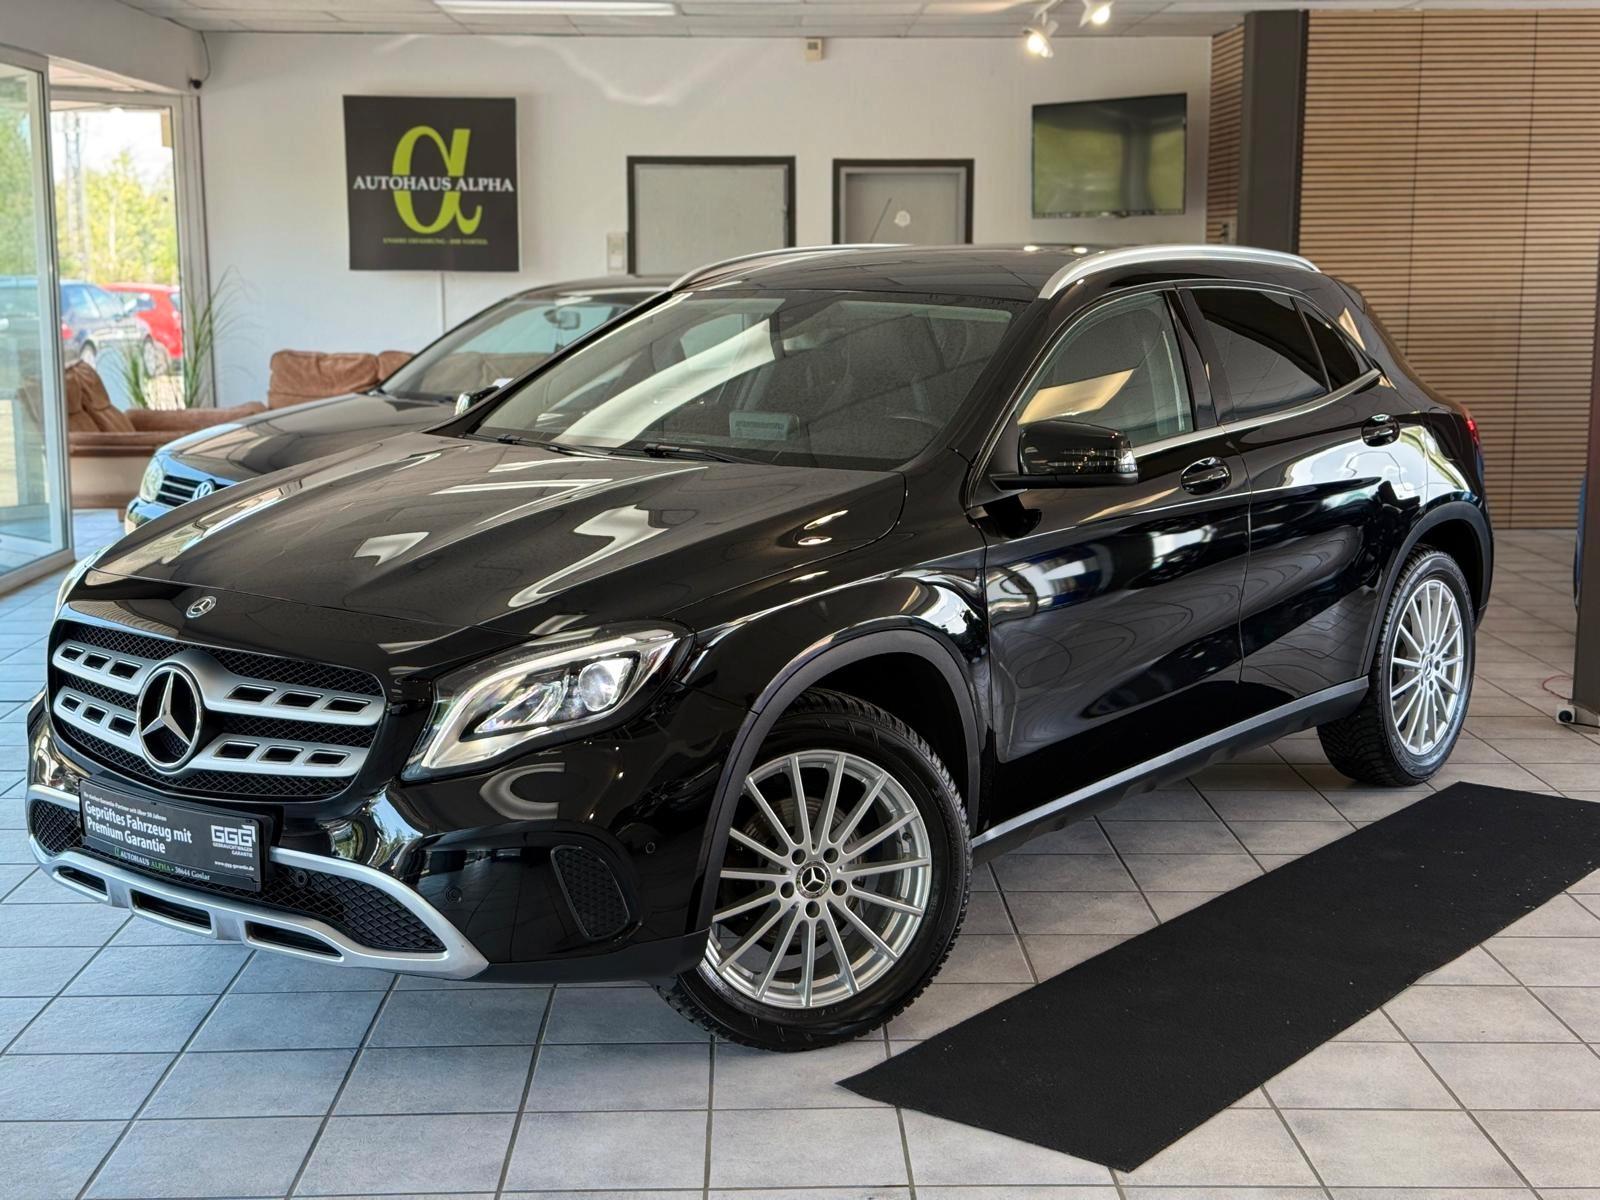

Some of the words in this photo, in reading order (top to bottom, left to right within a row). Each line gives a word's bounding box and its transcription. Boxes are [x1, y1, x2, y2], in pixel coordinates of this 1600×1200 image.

[353, 175, 451, 191] AUTOHAUS
[455, 177, 514, 192] ALPHA
[85, 801, 125, 827] Geprüftes
[126, 814, 171, 842] Fahrzeug
[173, 828, 192, 843] mit
[87, 816, 123, 841] Premium
[124, 830, 166, 854] Garantie
[211, 825, 254, 847] GGG
[120, 851, 149, 867] AUTOHAUS
